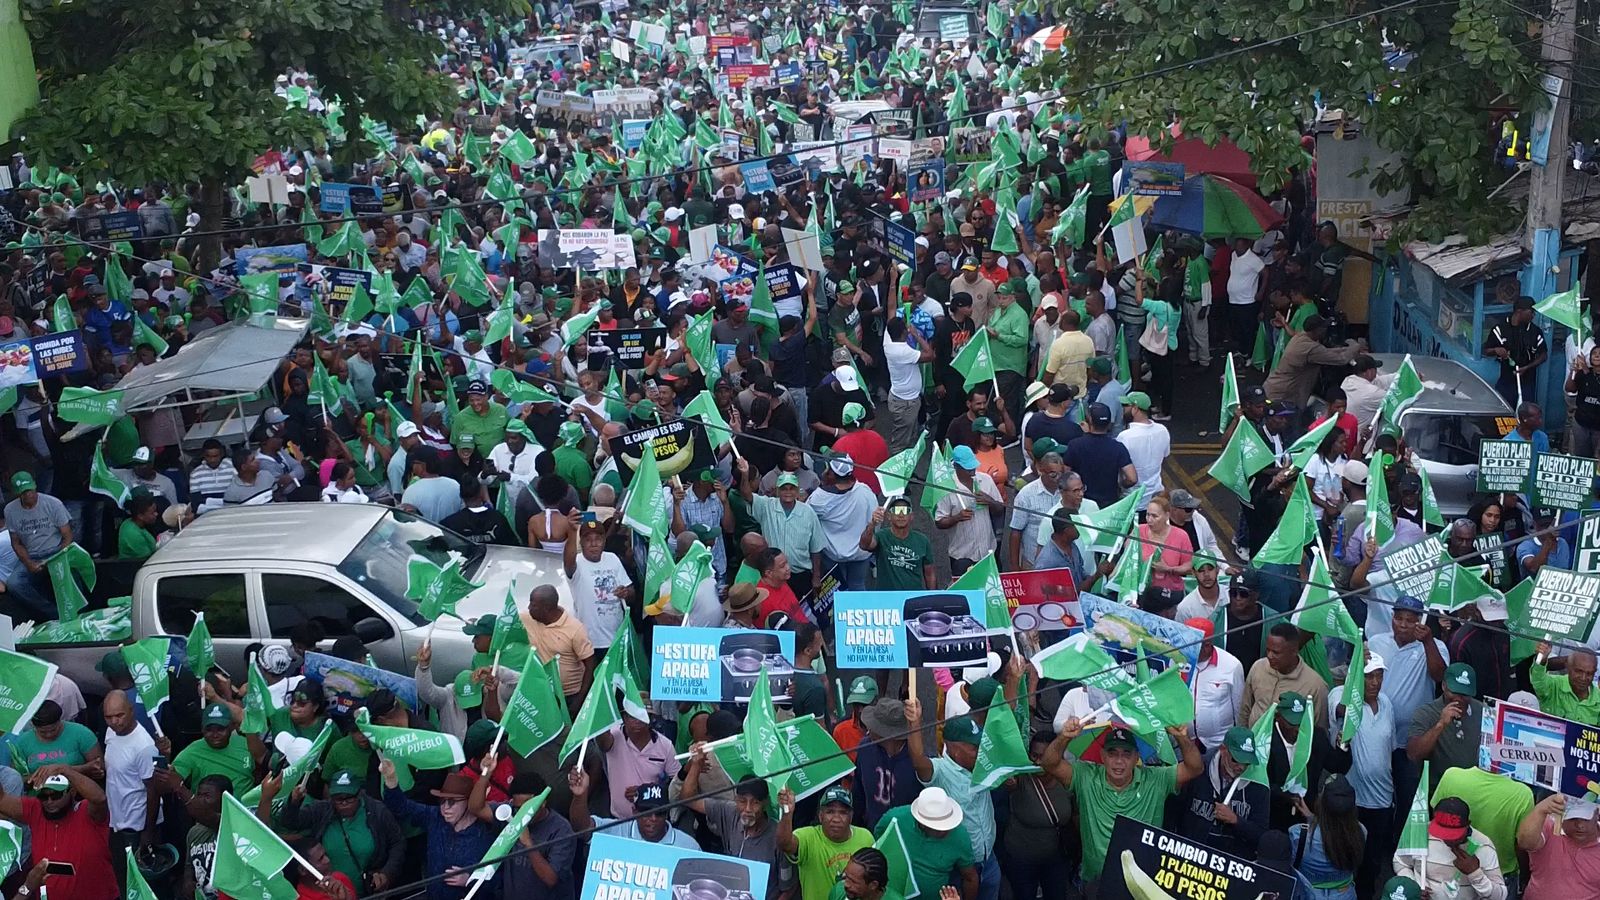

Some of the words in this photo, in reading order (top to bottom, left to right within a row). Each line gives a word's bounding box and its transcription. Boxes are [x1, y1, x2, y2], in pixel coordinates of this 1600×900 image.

[1321, 202, 1367, 214] PRESTA
[35, 340, 60, 351] COMIDA
[61, 337, 75, 345] POR
[40, 350, 52, 358] LAS
[53, 345, 73, 355] NUBES
[623, 436, 632, 445] EL
[632, 428, 659, 442] CAMBIO
[660, 426, 669, 435] ES
[669, 422, 685, 432] ESO:
[654, 442, 679, 457] PESOS
[1482, 442, 1509, 458] PUERTO
[1511, 443, 1531, 459] PLATA
[1486, 459, 1526, 467] PIDE
[1538, 454, 1568, 475] PUERTO
[1570, 459, 1594, 478] PLATA
[1541, 472, 1588, 486] PIDE
[1384, 547, 1417, 574] PUERTO
[1415, 536, 1442, 560] PLATA
[1536, 569, 1573, 593] PUERTO
[1570, 574, 1600, 597] PLATA
[1004, 588, 1014, 597] DE
[1537, 590, 1587, 606] PIDE
[838, 612, 847, 621] LA
[847, 609, 901, 626] ESTUFA
[845, 626, 895, 646] APAGÁ
[656, 645, 664, 654] LA
[664, 643, 716, 661] ESTUFA
[852, 646, 856, 654] Y
[857, 646, 864, 654] EN
[866, 646, 872, 654] LA
[873, 646, 889, 654] MESA
[661, 660, 709, 679] APAGÁ
[662, 686, 670, 694] NO
[671, 686, 682, 695] HAY
[691, 687, 699, 695] DE
[517, 711, 543, 737] PUEBLO
[385, 732, 418, 749] FUERZA
[1576, 738, 1586, 748] NI
[1582, 729, 1598, 741] SIN
[407, 736, 442, 755] PUEBLO
[1570, 746, 1589, 760] NOS
[1500, 747, 1556, 763] CERRADA
[1577, 759, 1583, 769] A
[1586, 761, 1598, 773] LA
[1141, 829, 1155, 847] EL
[1158, 835, 1208, 865] CAMBIO
[1209, 853, 1226, 872] ES
[1227, 860, 1257, 883] ESO:
[591, 860, 602, 872] LA
[600, 858, 669, 890] ESTUFA
[1160, 855, 1166, 867] 1
[1167, 857, 1213, 884] PLÁTANO
[1214, 873, 1229, 890] EN
[1154, 868, 1175, 889] 40
[1177, 876, 1227, 900] PESOS
